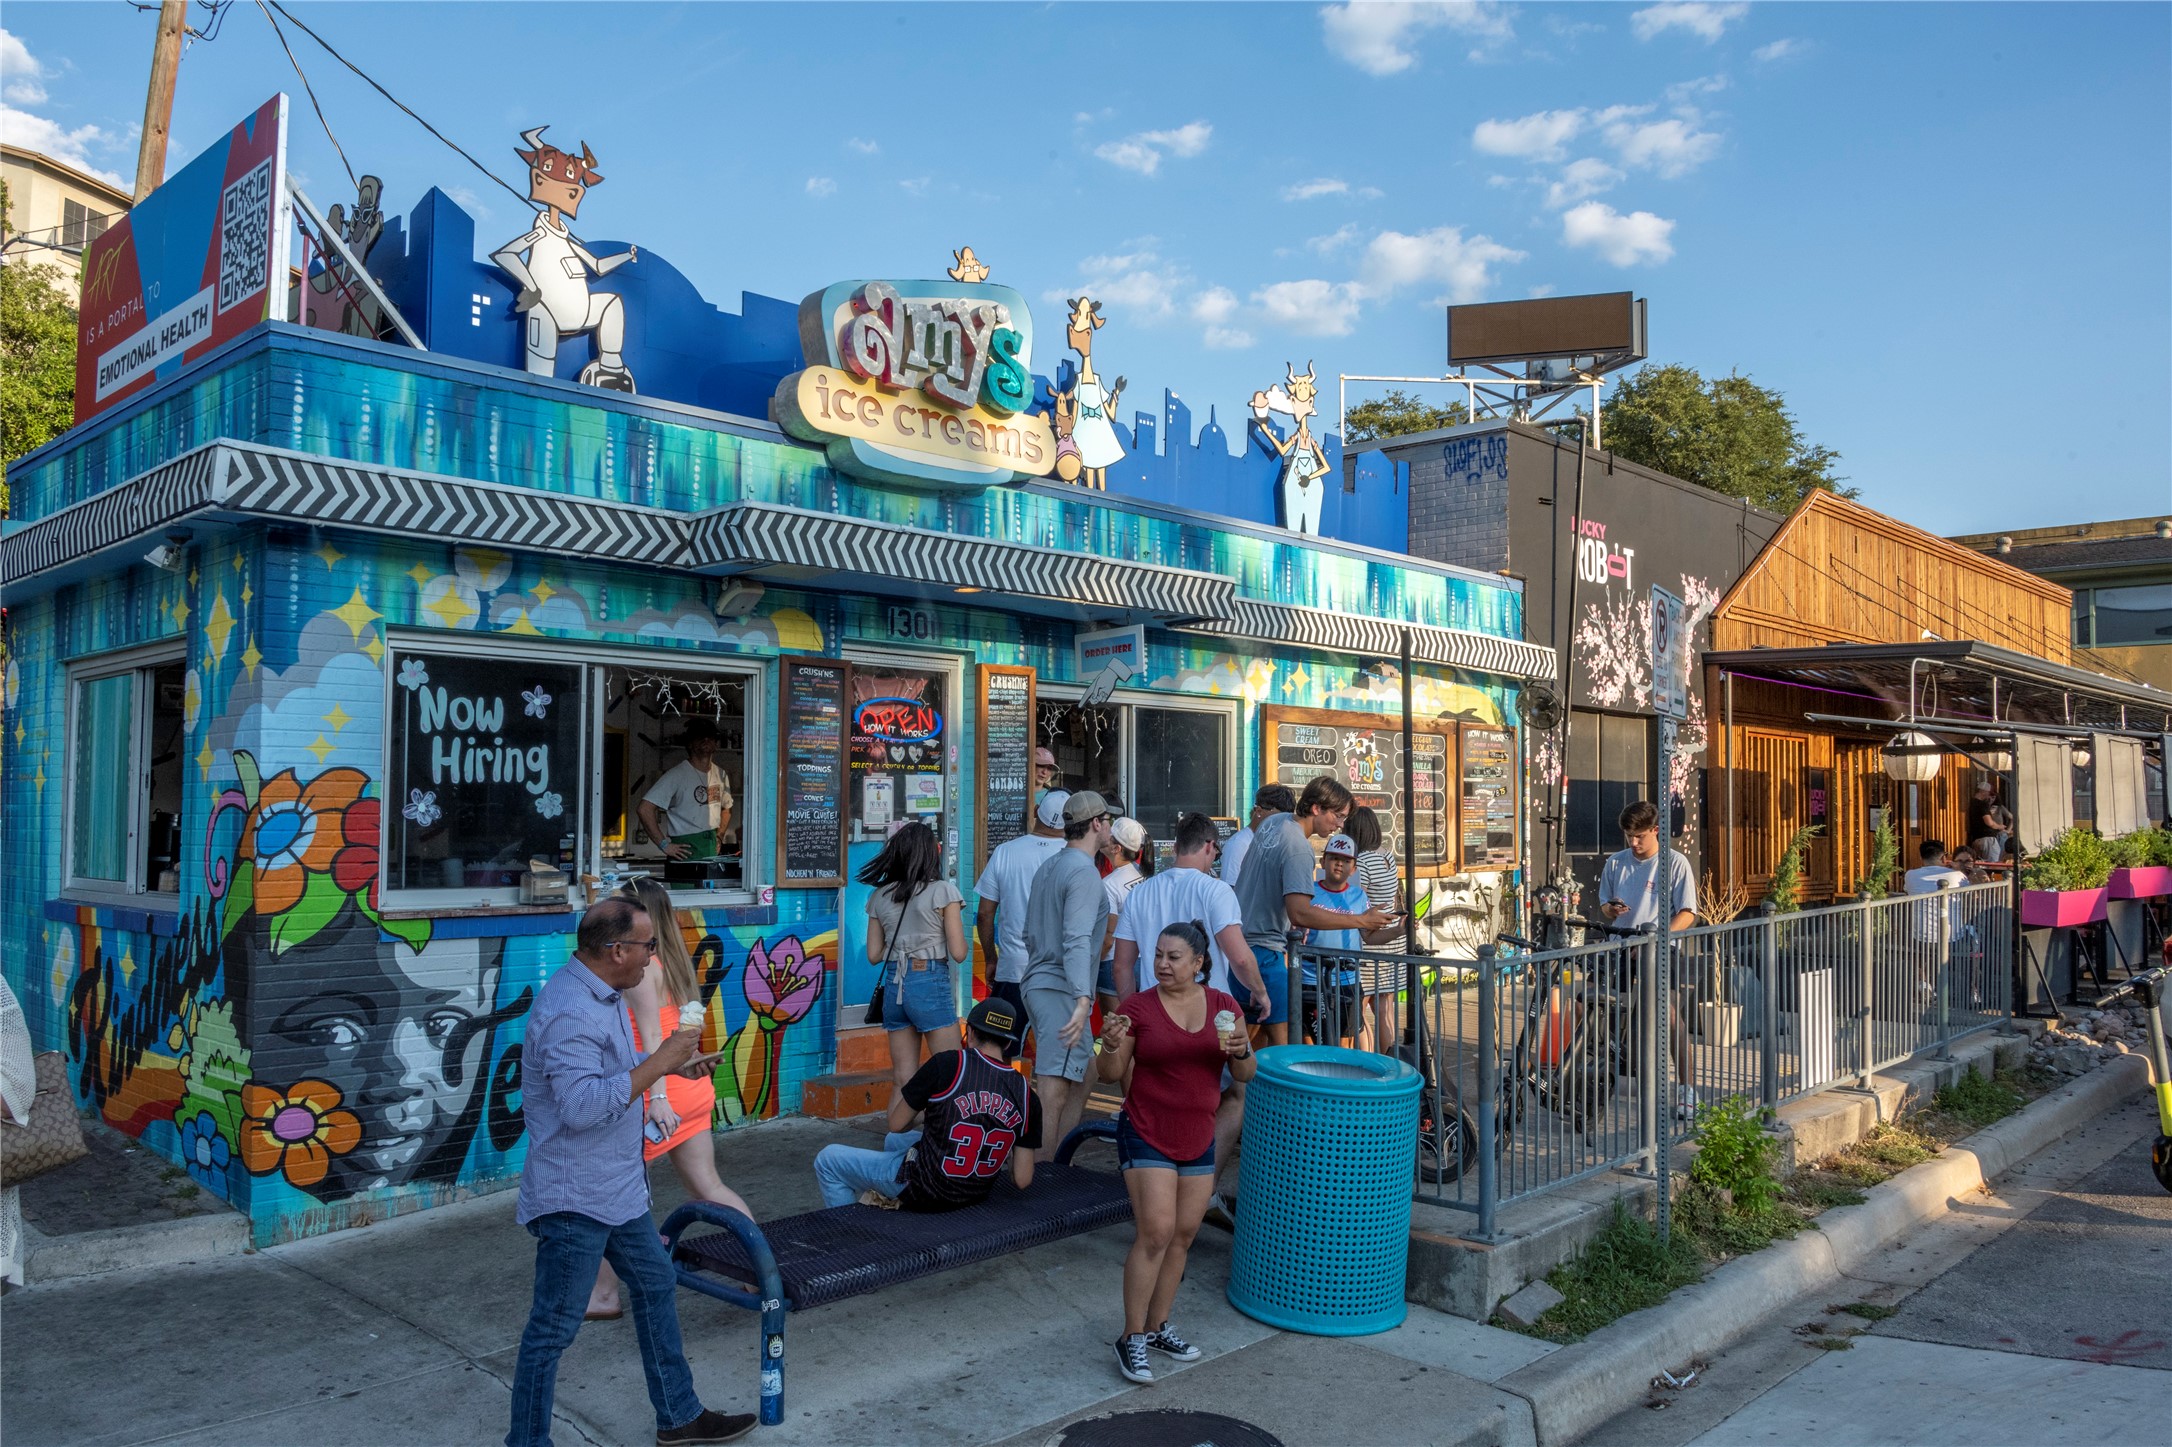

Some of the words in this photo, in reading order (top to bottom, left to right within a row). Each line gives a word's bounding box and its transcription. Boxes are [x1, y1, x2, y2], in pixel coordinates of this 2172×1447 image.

[88, 235, 129, 309] ART
[86, 328, 95, 345] IS
[98, 321, 105, 338] A
[108, 293, 144, 331] PORTAL
[148, 280, 160, 302] TO
[99, 336, 158, 388] EMOTIONAL
[160, 303, 208, 351] HEALTH
[816, 374, 884, 427] ice
[893, 404, 1043, 463] creams
[890, 607, 936, 640] 1301
[1085, 647, 1110, 658] ORDER
[1112, 643, 1132, 654] HERE
[799, 667, 834, 678] CRUSH'NS
[860, 706, 934, 735] OPEN
[864, 724, 884, 733] HOW
[900, 729, 929, 737] WORKS
[1295, 726, 1320, 736] SWEET
[1467, 730, 1480, 738] HOW
[1482, 731, 1488, 739] IT
[1295, 736, 1320, 744] CREAM
[1412, 736, 1433, 744] ELGIAN
[1303, 749, 1331, 764] OREO
[432, 735, 549, 794] Hiring
[797, 764, 832, 773] TOPPINGS
[918, 764, 940, 772] TOPPING
[1413, 762, 1432, 770] ANILLA
[1292, 767, 1322, 776] MEXICAN
[990, 776, 1024, 790] COMBOS
[1351, 781, 1360, 790] ice
[1361, 783, 1381, 791] creams
[1398, 791, 1433, 809] Cffee
[787, 810, 811, 819] MOVIE
[813, 810, 838, 819] QUOTE!
[1334, 839, 1347, 850] M
[560, 863, 574, 871] VISA
[954, 1090, 1023, 1129] PIPPEN
[941, 1121, 1016, 1178] 33
